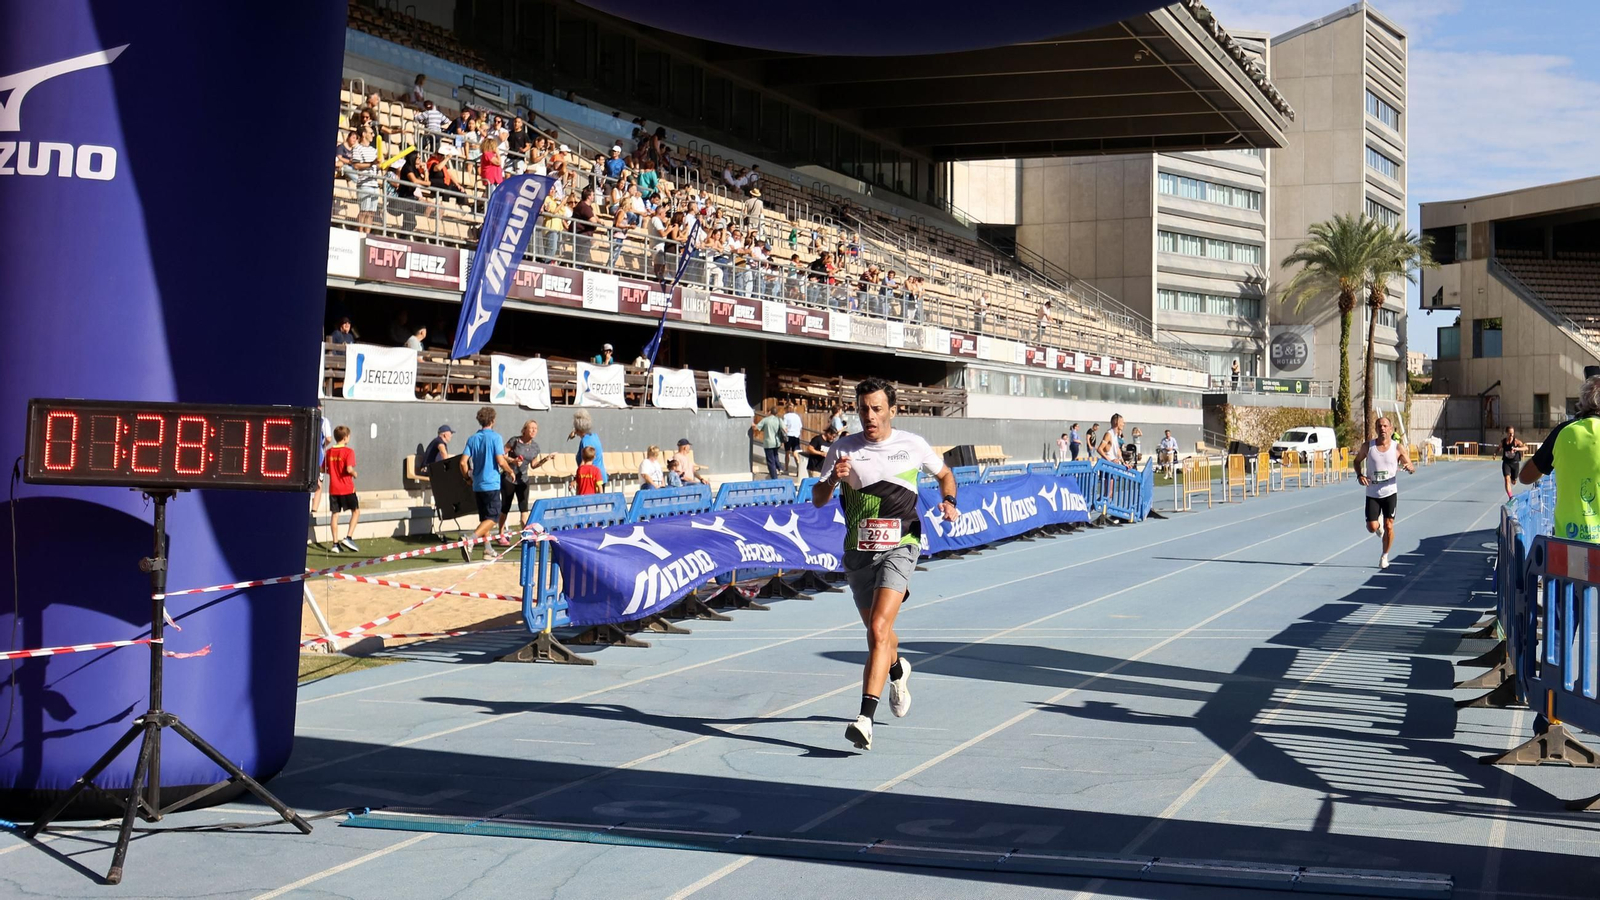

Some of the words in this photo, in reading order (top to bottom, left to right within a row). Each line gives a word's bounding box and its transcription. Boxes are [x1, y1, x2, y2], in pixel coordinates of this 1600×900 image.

[485, 178, 542, 295] MIZUNO
[369, 246, 404, 268] PLAY
[621, 287, 647, 304] PLAY
[712, 301, 734, 316] PLAY
[363, 369, 413, 385] JEREZ2031
[44, 410, 293, 478] 01:28:16
[867, 529, 889, 541] 296
[621, 549, 716, 616] MIZUNO
